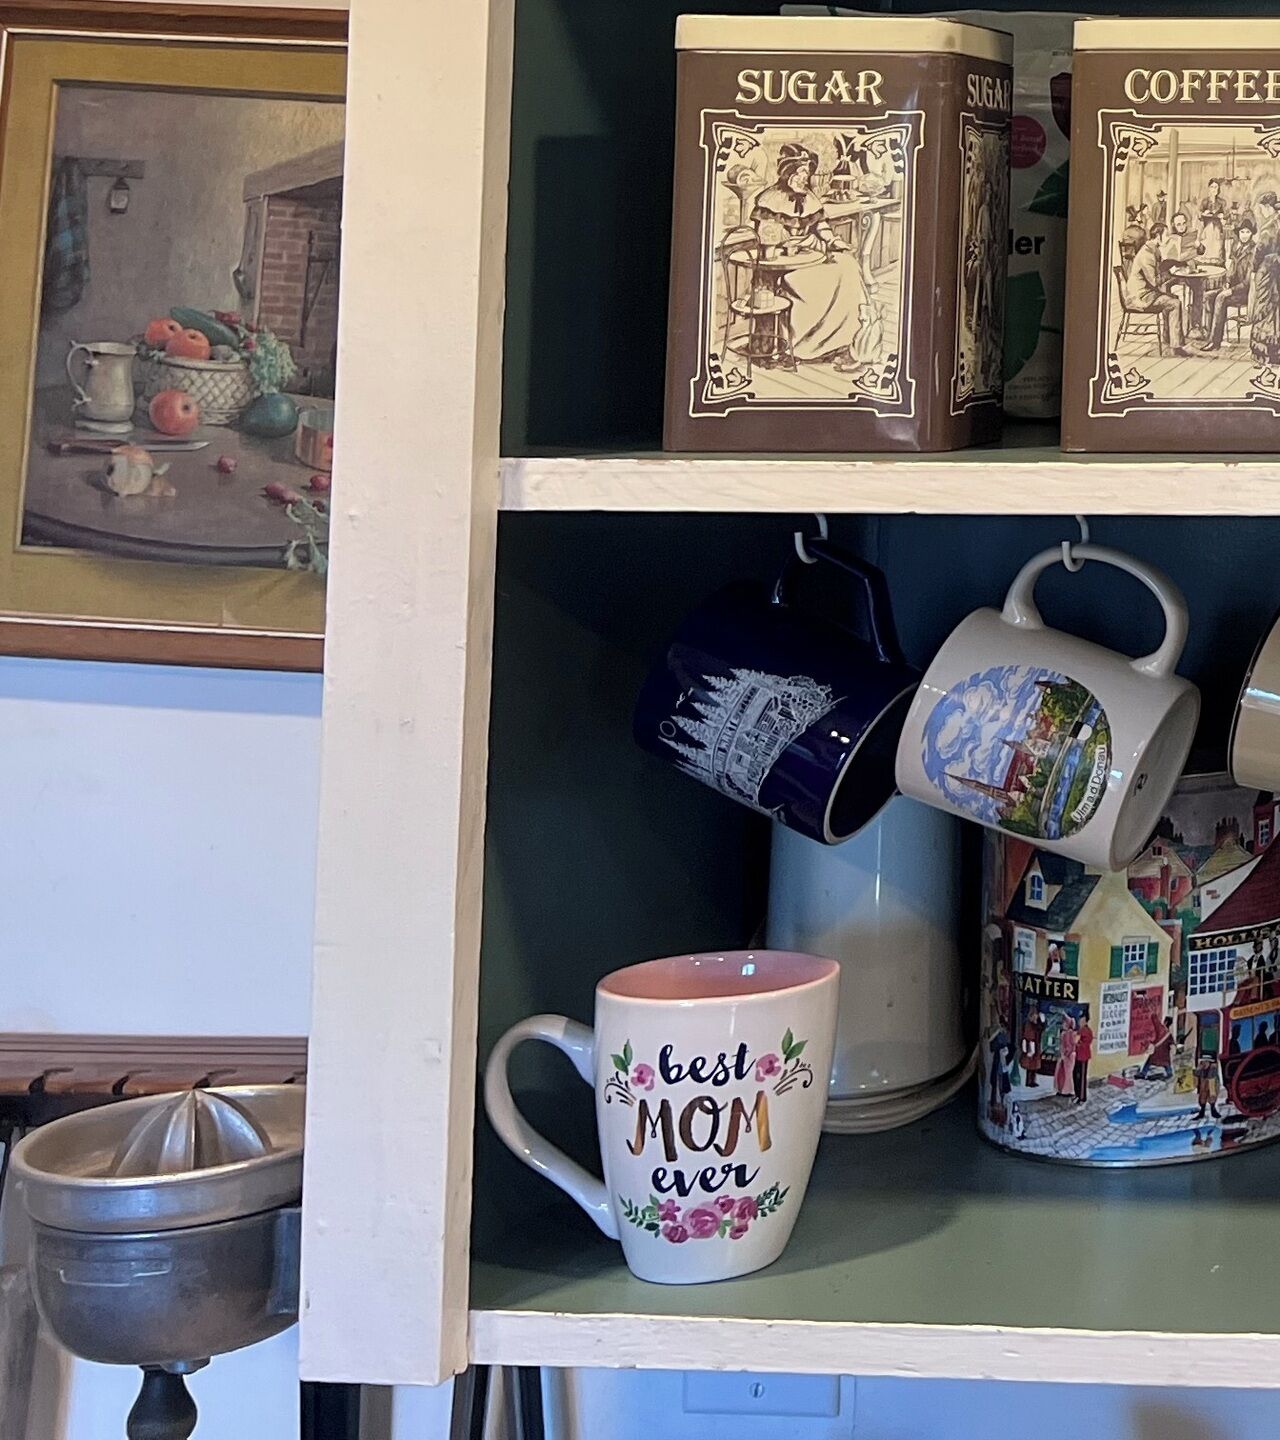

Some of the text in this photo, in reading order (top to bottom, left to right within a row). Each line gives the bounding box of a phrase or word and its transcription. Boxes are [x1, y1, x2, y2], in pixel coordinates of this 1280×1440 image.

[735, 69, 886, 106] SUGAR
[659, 1042, 756, 1086] best
[626, 1090, 772, 1162] MOM
[651, 1163, 760, 1197] ever
